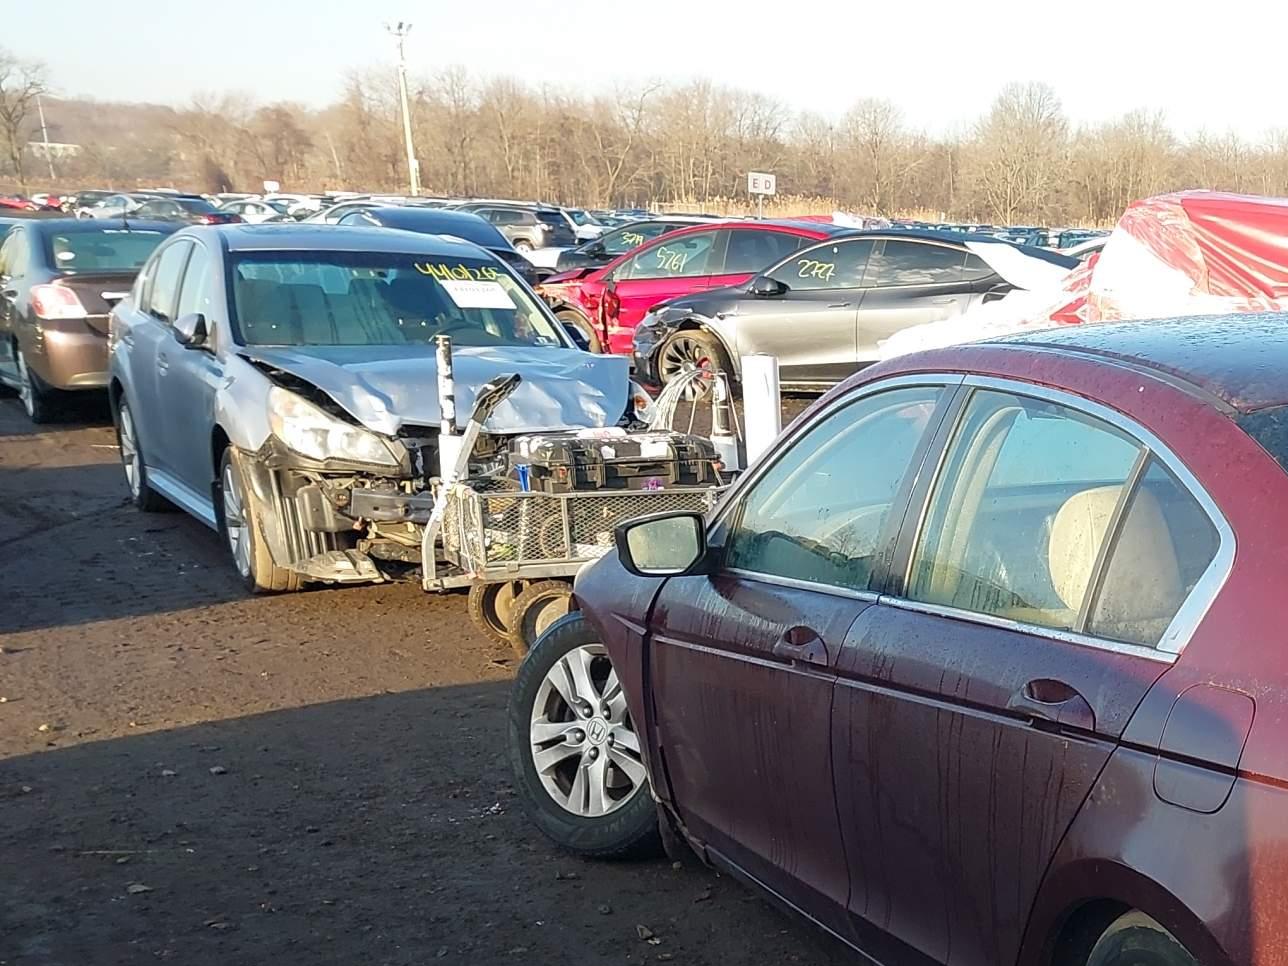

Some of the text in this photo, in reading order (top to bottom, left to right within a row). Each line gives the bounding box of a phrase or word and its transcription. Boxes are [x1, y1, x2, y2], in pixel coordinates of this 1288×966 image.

[752, 178, 772, 190] E D
[656, 246, 688, 273] 5761
